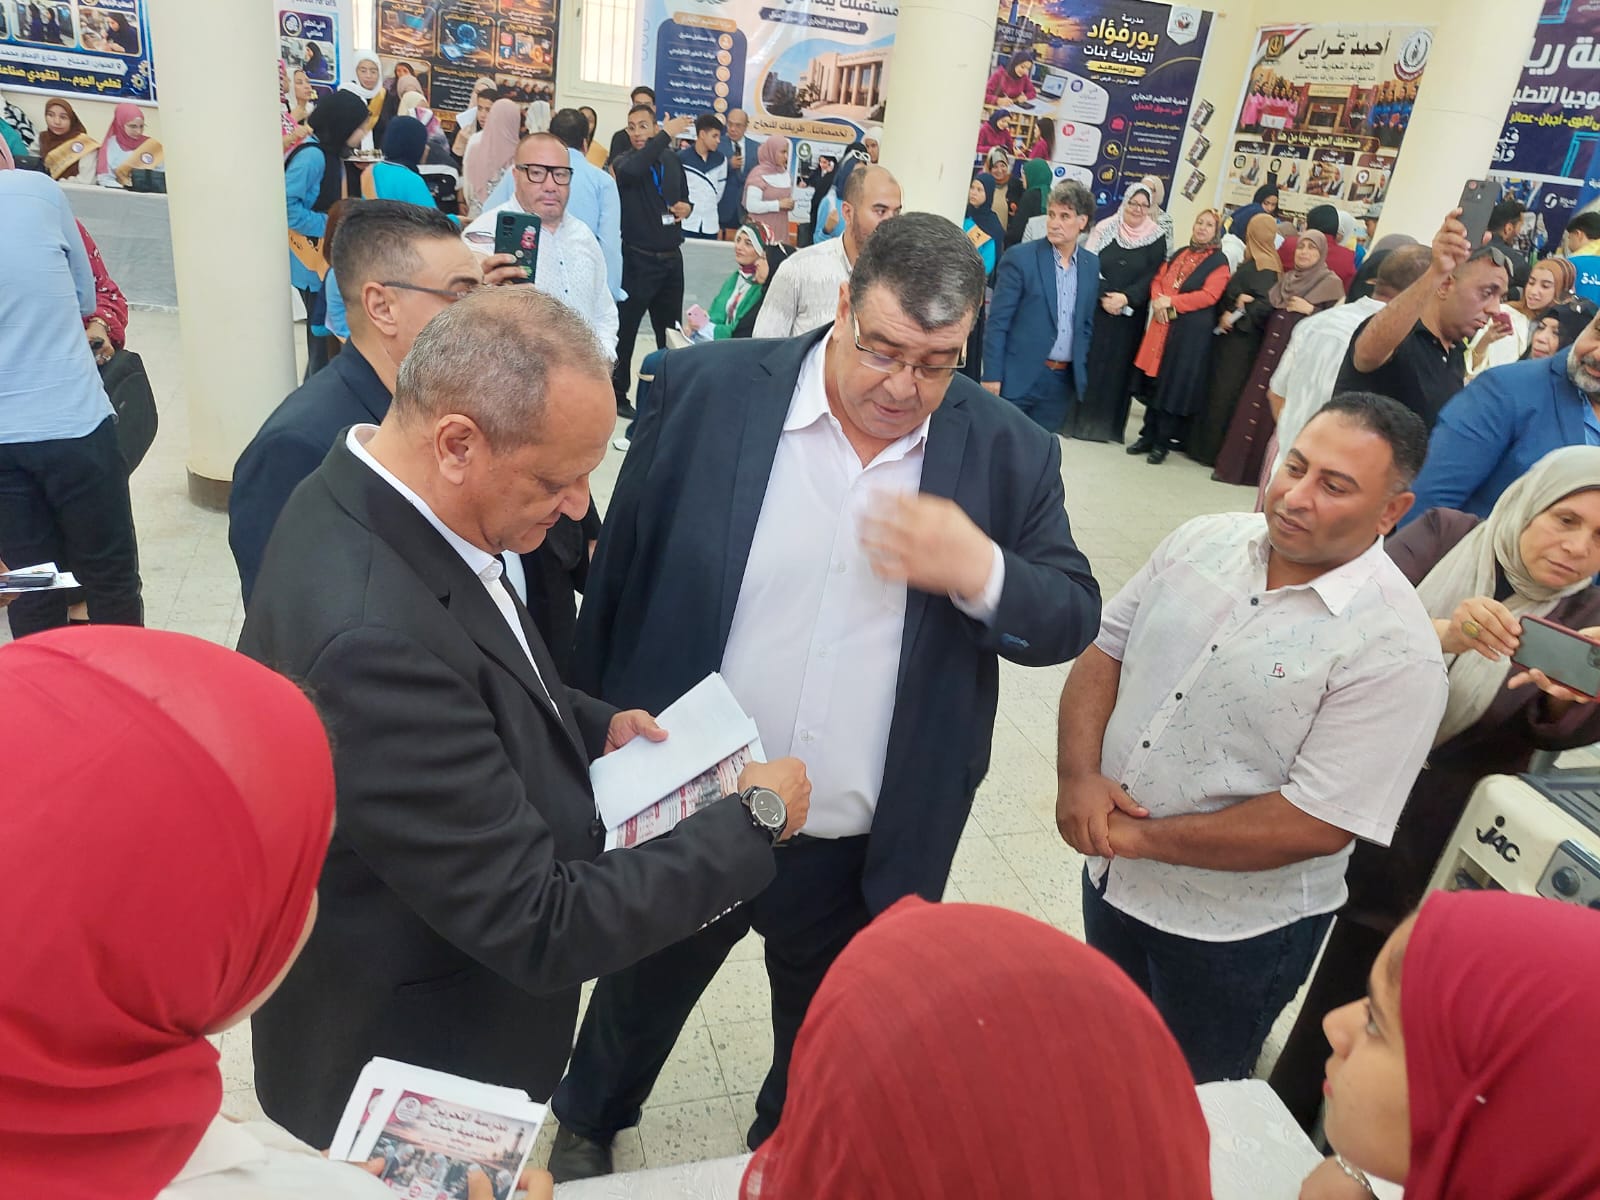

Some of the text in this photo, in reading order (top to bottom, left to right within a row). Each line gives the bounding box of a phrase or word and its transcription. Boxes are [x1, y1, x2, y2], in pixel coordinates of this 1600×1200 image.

[1121, 13, 1144, 24] مدرسة
[1087, 18, 1159, 52] بورفؤاد
[1298, 39, 1347, 63] عرابي
[1350, 30, 1392, 57] أحمد
[1083, 44, 1154, 64] التجارية بنات
[26, 68, 60, 83] لتقودي
[96, 78, 122, 91] تعلمي
[753, 119, 778, 130] للنجاح
[1332, 136, 1361, 149] مستقبلك
